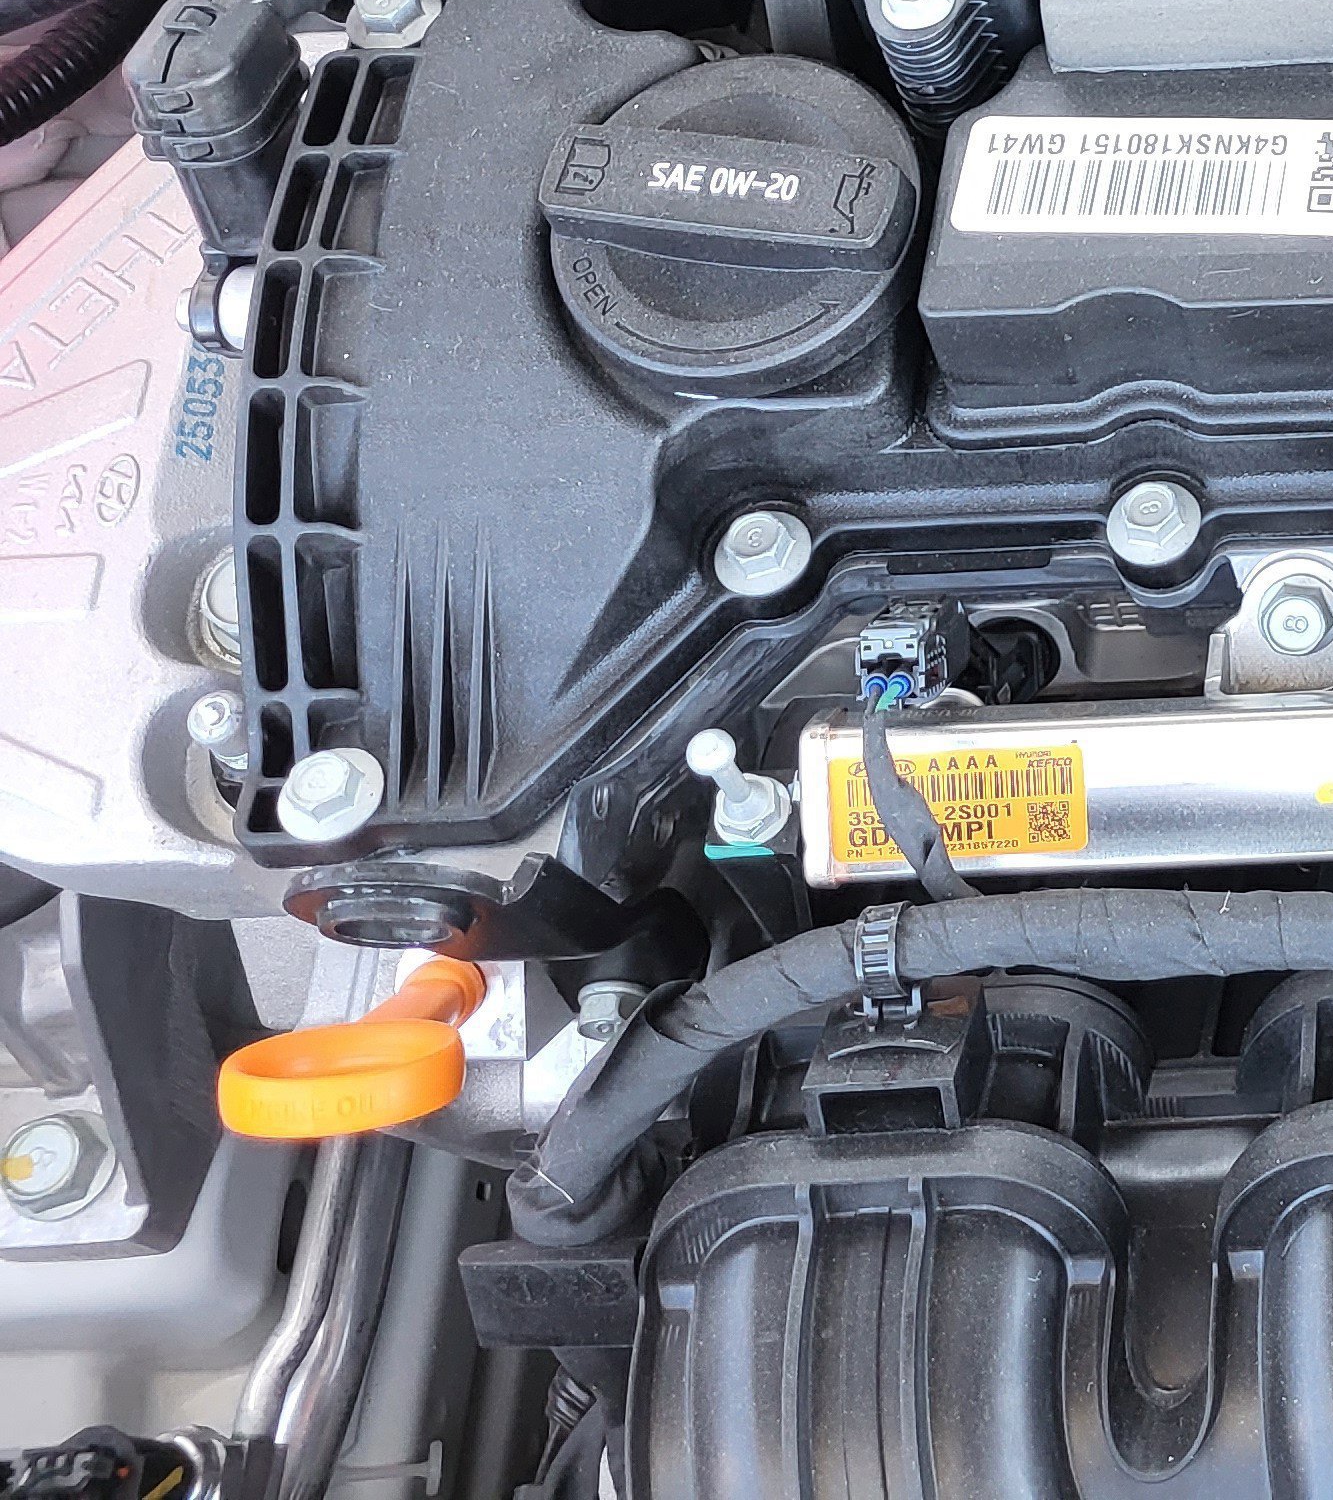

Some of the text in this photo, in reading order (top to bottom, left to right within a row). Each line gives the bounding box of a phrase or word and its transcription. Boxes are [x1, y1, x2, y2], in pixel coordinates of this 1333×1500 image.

[986, 131, 1288, 157] G4KNSK180151 GW41
[648, 162, 801, 202] SAE 0W-20
[0, 207, 198, 388] THETA
[573, 257, 619, 317] OPEN
[175, 345, 226, 462] 25053
